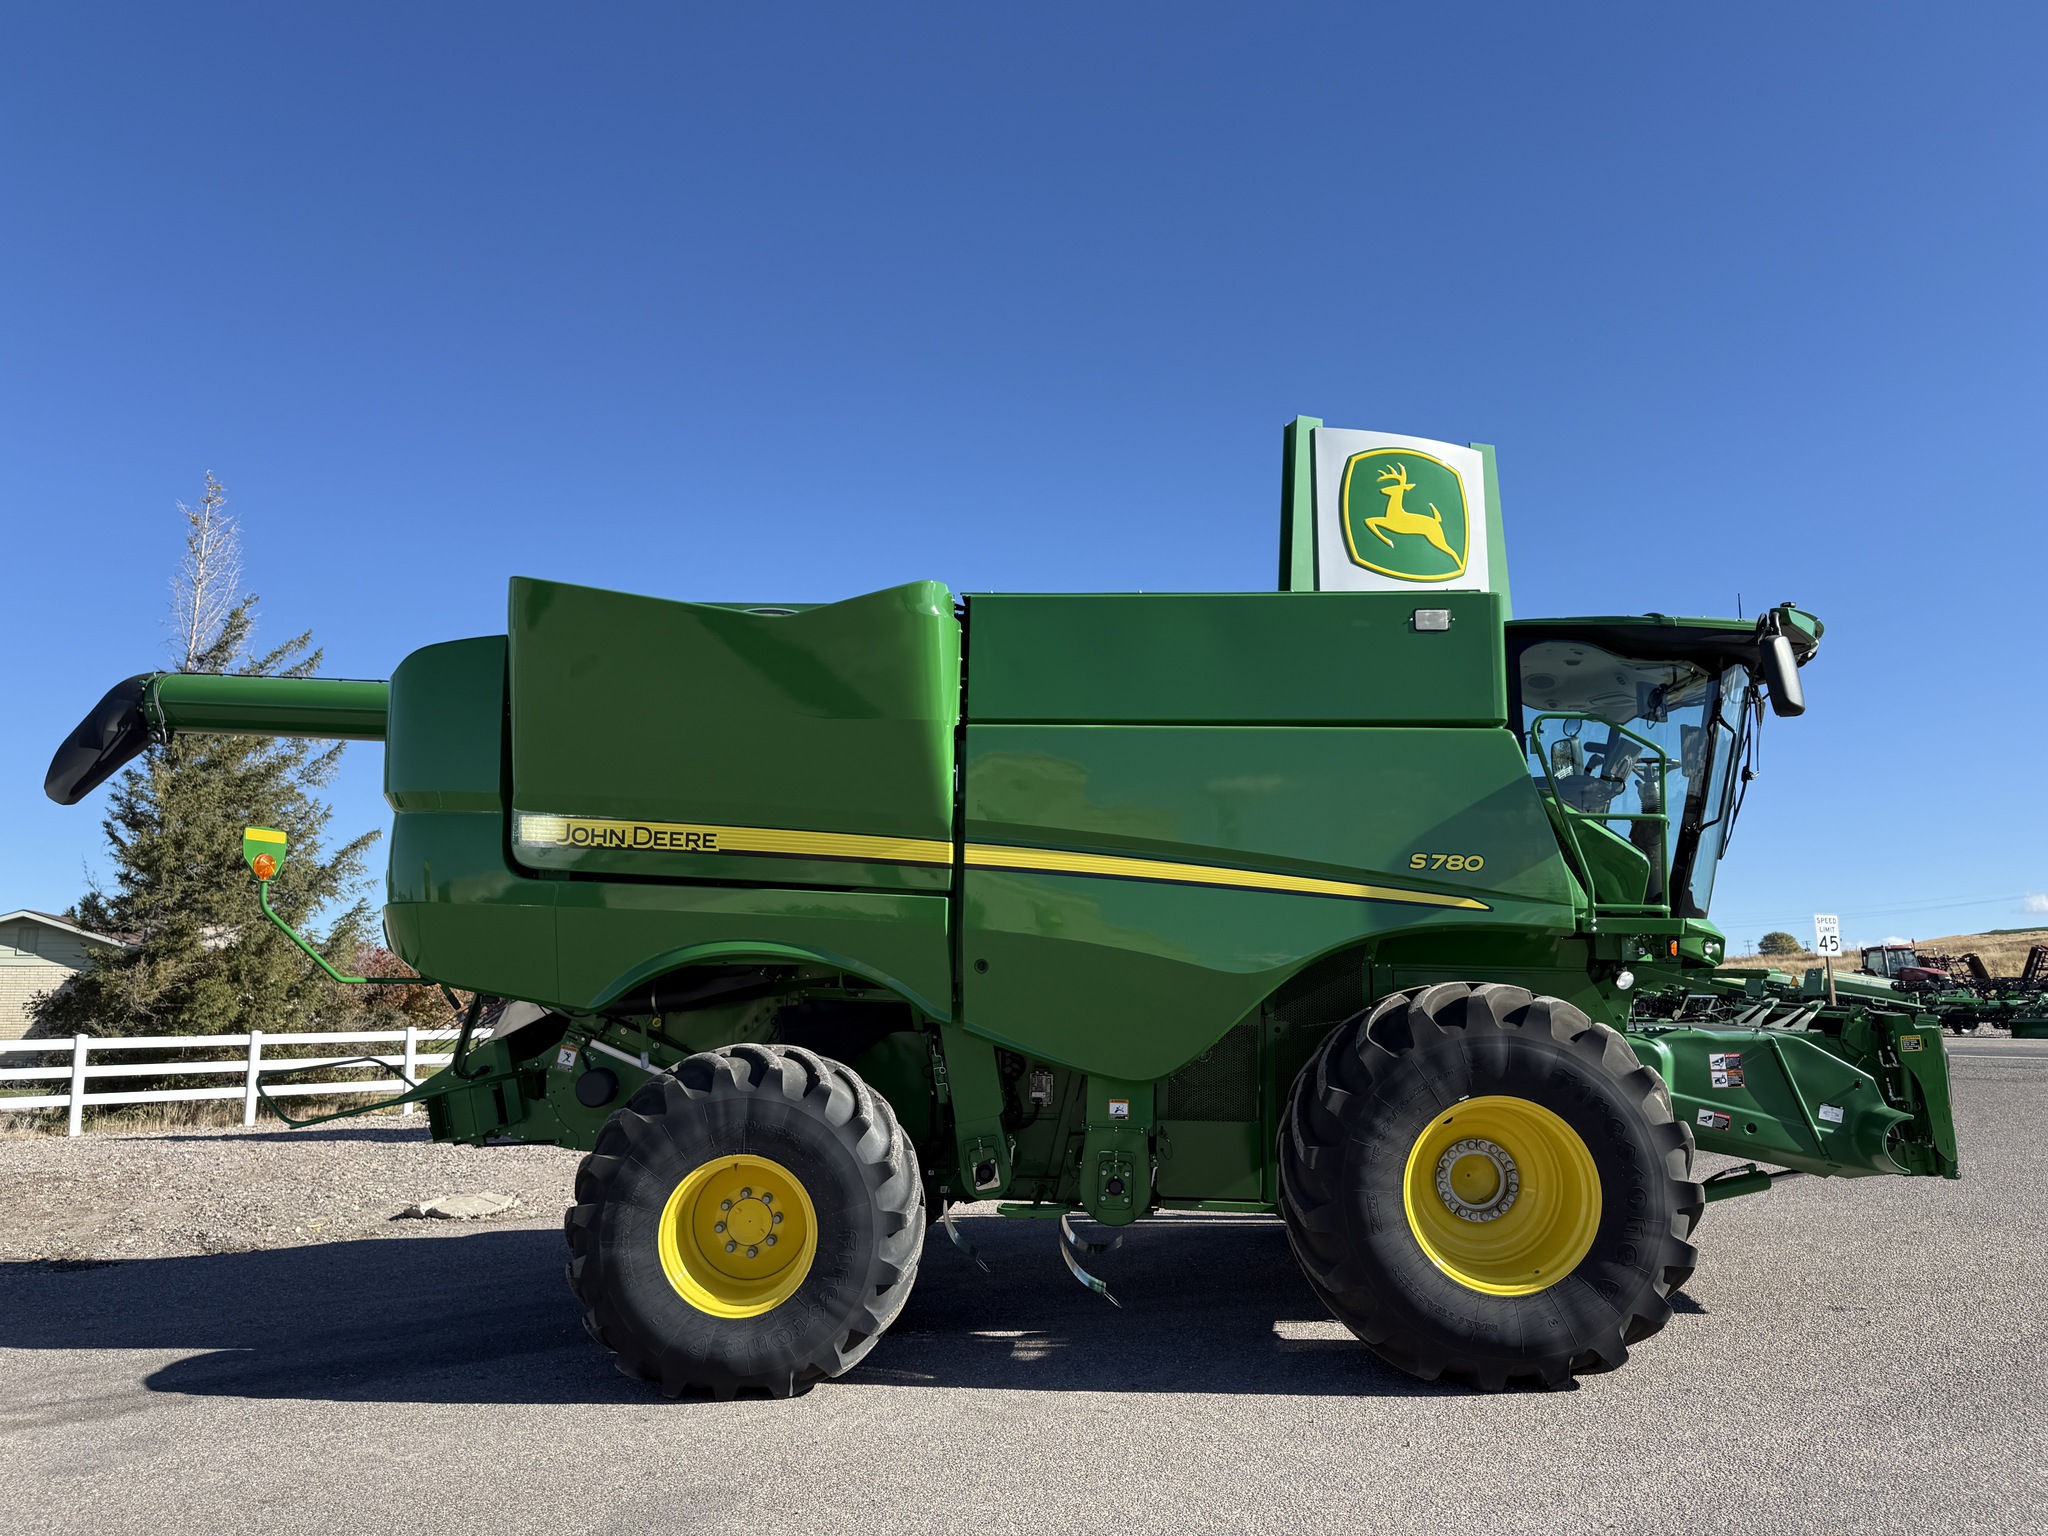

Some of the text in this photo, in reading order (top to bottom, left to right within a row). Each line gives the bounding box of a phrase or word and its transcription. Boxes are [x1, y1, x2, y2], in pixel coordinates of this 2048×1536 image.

[556, 823, 718, 850] JOHN DEERE
[1409, 853, 1485, 872] S780
[1816, 917, 1837, 925] SPEED
[1819, 935, 1839, 952] 45
